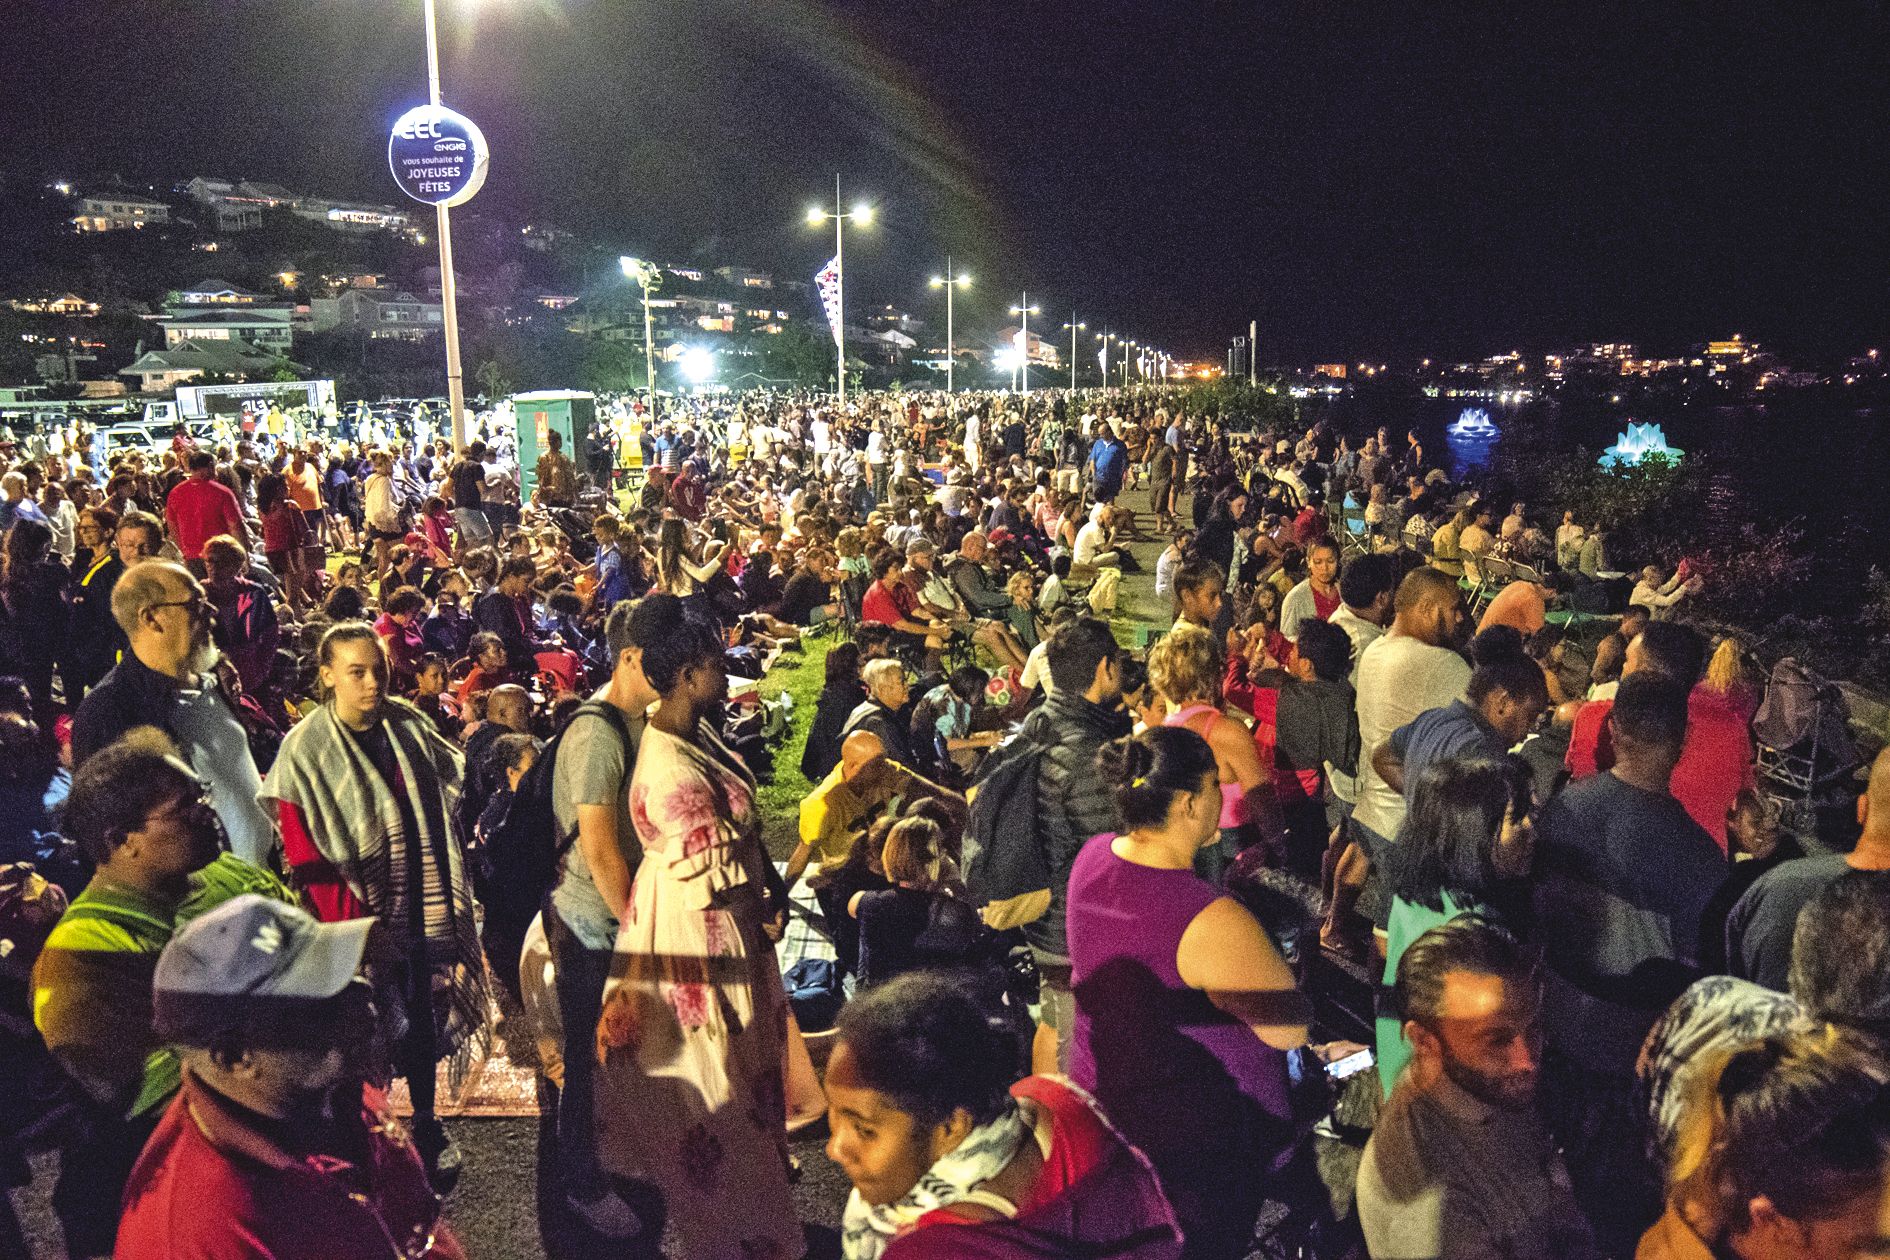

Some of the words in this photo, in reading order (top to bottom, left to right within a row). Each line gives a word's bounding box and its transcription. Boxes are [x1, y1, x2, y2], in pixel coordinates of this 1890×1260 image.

[402, 158, 421, 166] vous
[422, 156, 453, 165] souhaite
[454, 155, 464, 163] de
[408, 166, 460, 179] JOYEUSES
[419, 180, 451, 193] FÊTES
